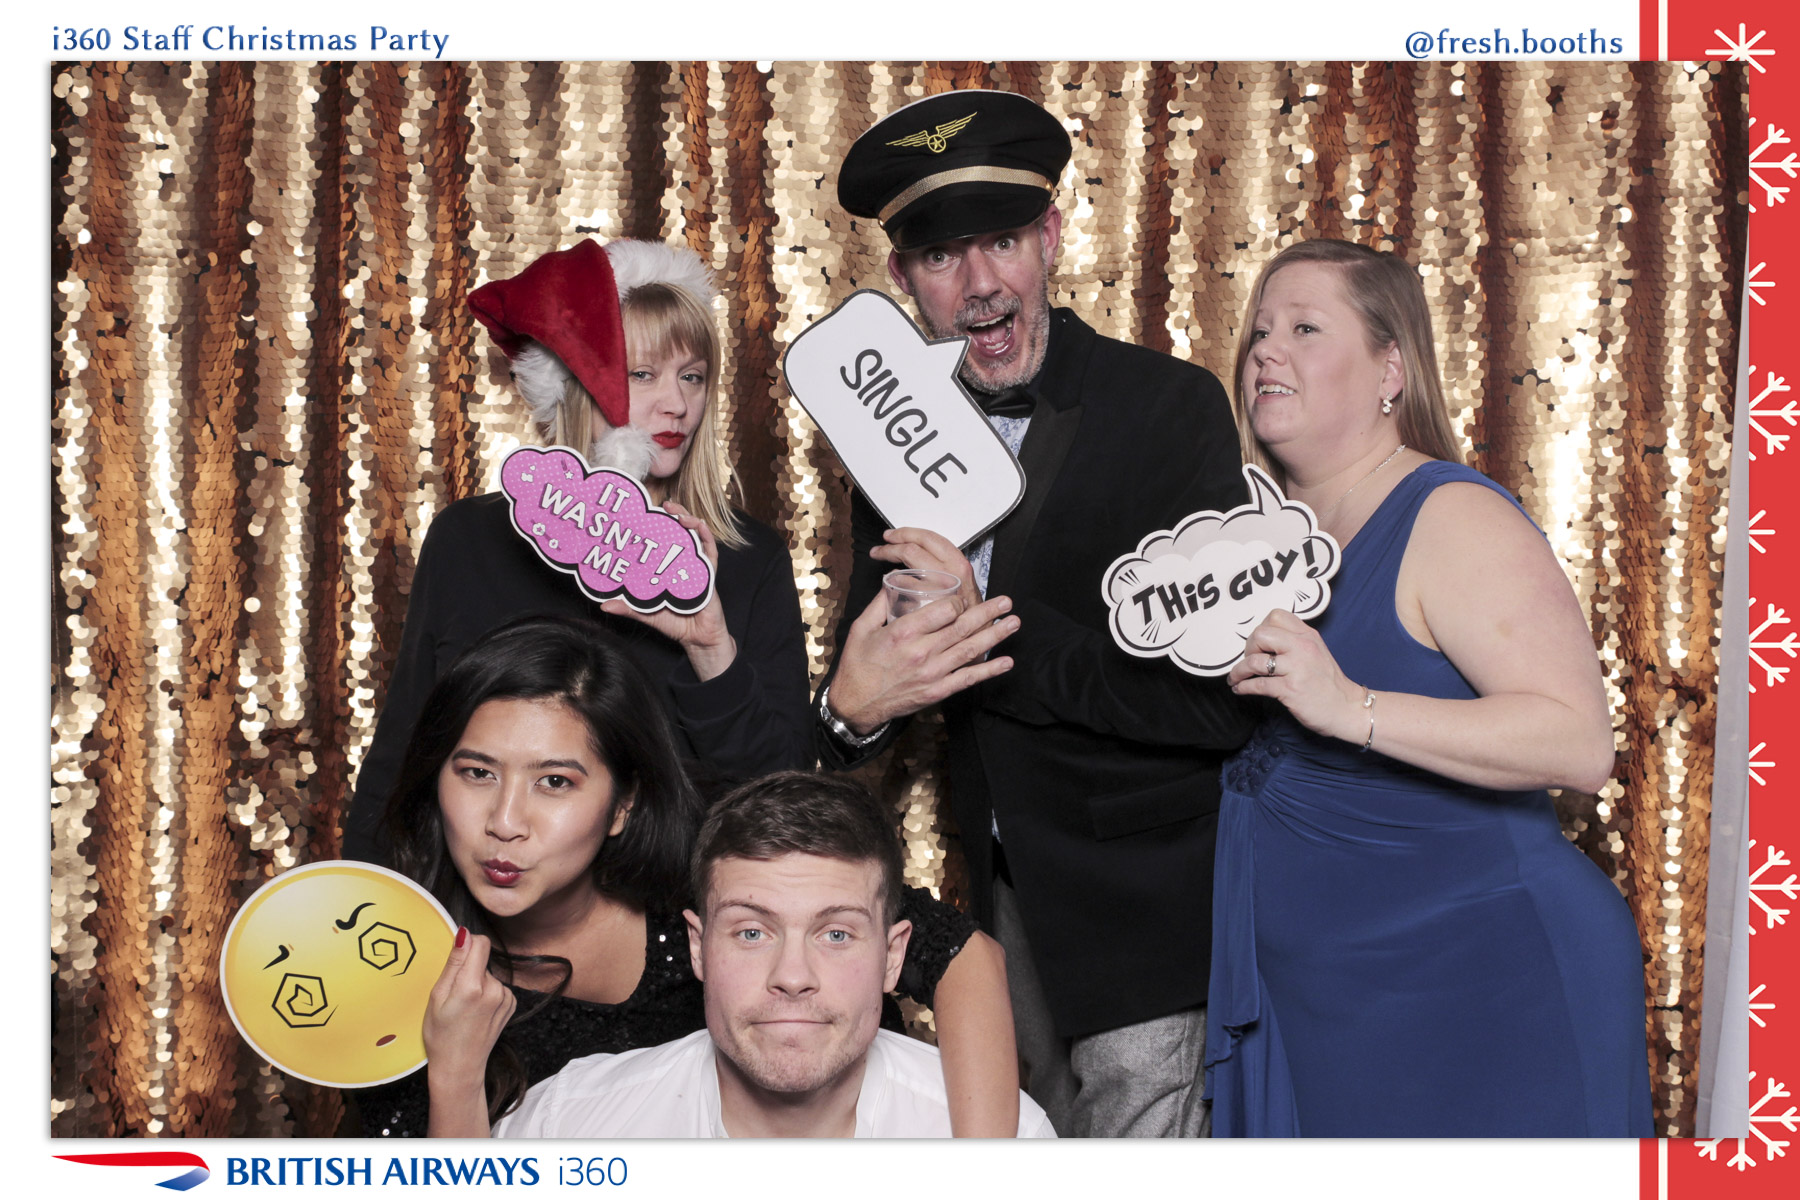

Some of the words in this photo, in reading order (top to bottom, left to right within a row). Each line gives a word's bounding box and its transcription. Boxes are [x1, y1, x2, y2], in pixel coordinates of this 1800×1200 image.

[840, 349, 968, 499] SINGLE
[598, 482, 630, 513] IT
[1229, 538, 1319, 602] GUY!
